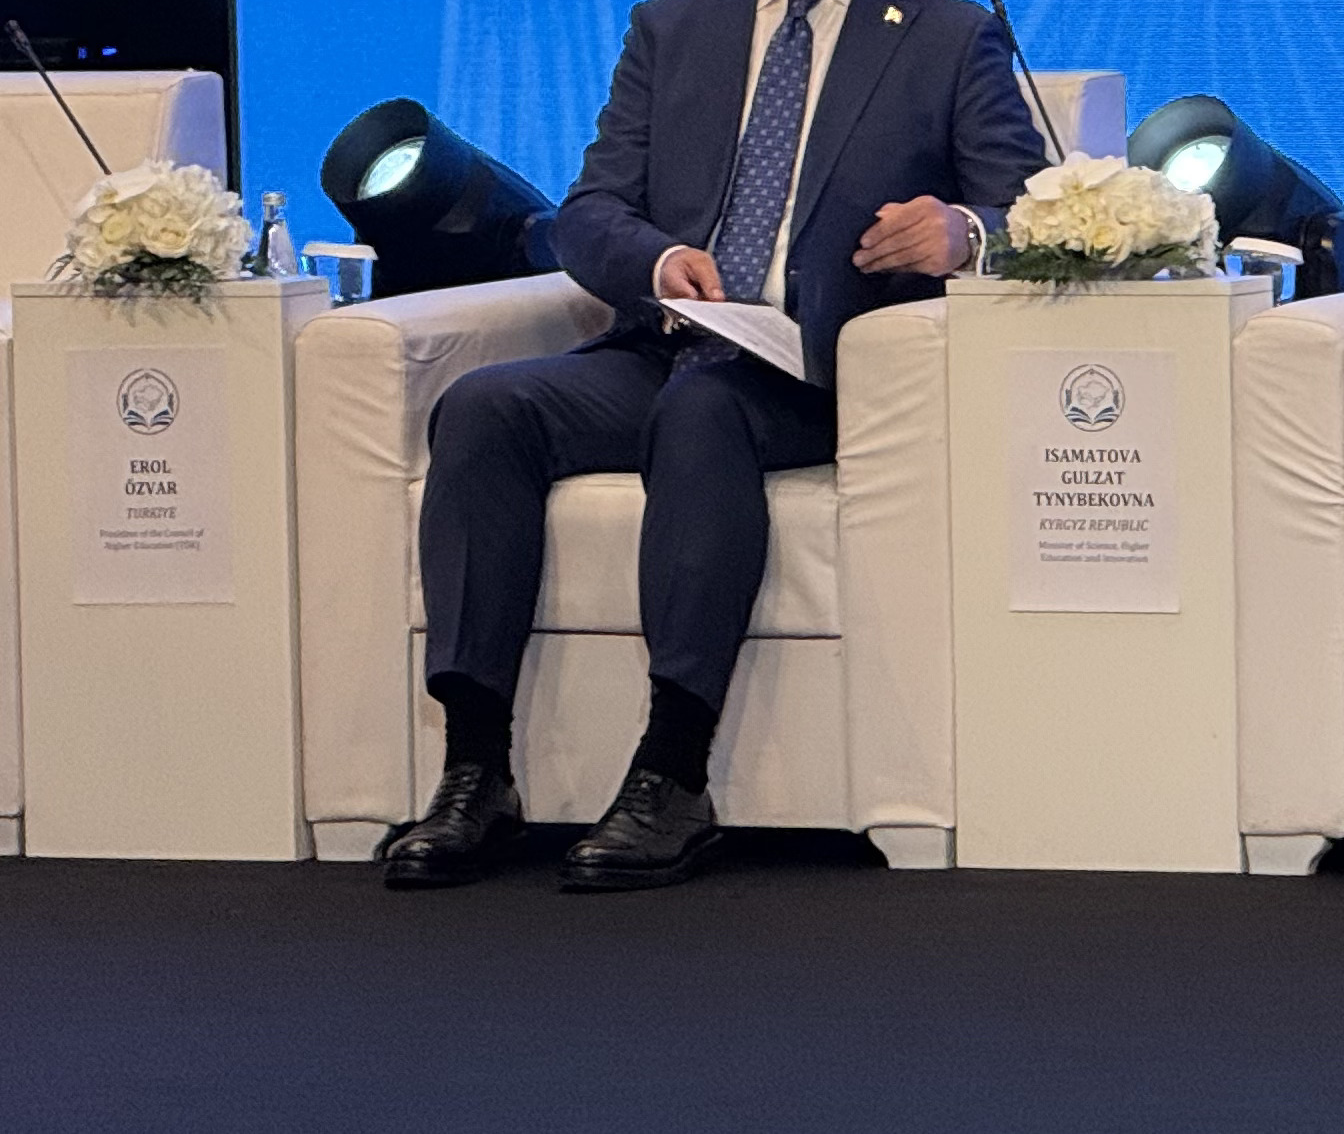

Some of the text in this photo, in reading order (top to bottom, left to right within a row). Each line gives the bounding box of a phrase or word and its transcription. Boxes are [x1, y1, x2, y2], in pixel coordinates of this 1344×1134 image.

[1045, 448, 1141, 463] ISAMATOVA
[130, 459, 171, 474] EROL
[1061, 470, 1126, 485] GULZAT
[125, 478, 177, 495] ÖZVAR
[1033, 491, 1155, 507] TYNYBEKOVNA
[1039, 518, 1149, 532] KYRGYZ REPUBLIC
